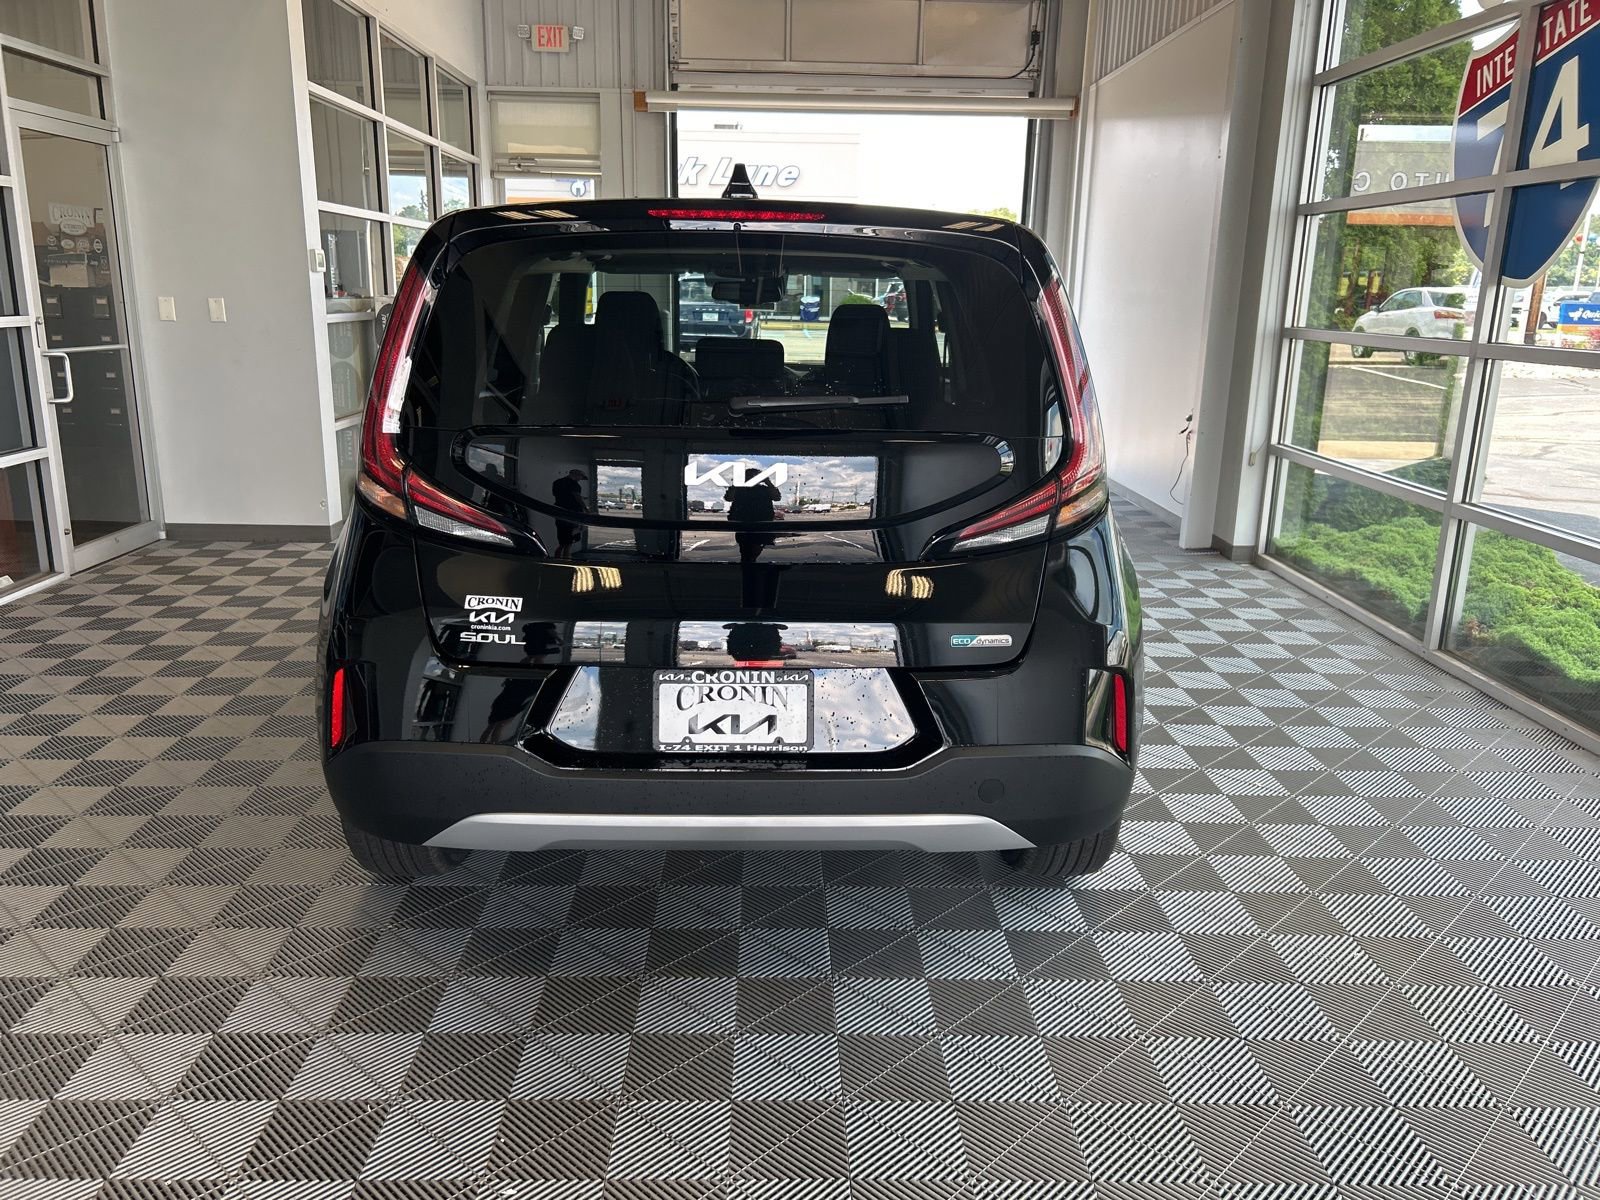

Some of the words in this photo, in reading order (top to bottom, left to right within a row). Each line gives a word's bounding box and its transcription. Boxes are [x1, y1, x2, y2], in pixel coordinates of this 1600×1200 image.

[537, 26, 563, 48] EXIT
[709, 157, 800, 187] Lne
[684, 461, 787, 487] KIA
[468, 597, 520, 610] CRONIN
[469, 611, 515, 624] KIA
[460, 632, 527, 645] SOUL
[659, 673, 684, 681] KIA
[691, 671, 775, 684] CRONIN
[676, 685, 788, 711] CRONIN
[688, 713, 778, 735] KIA
